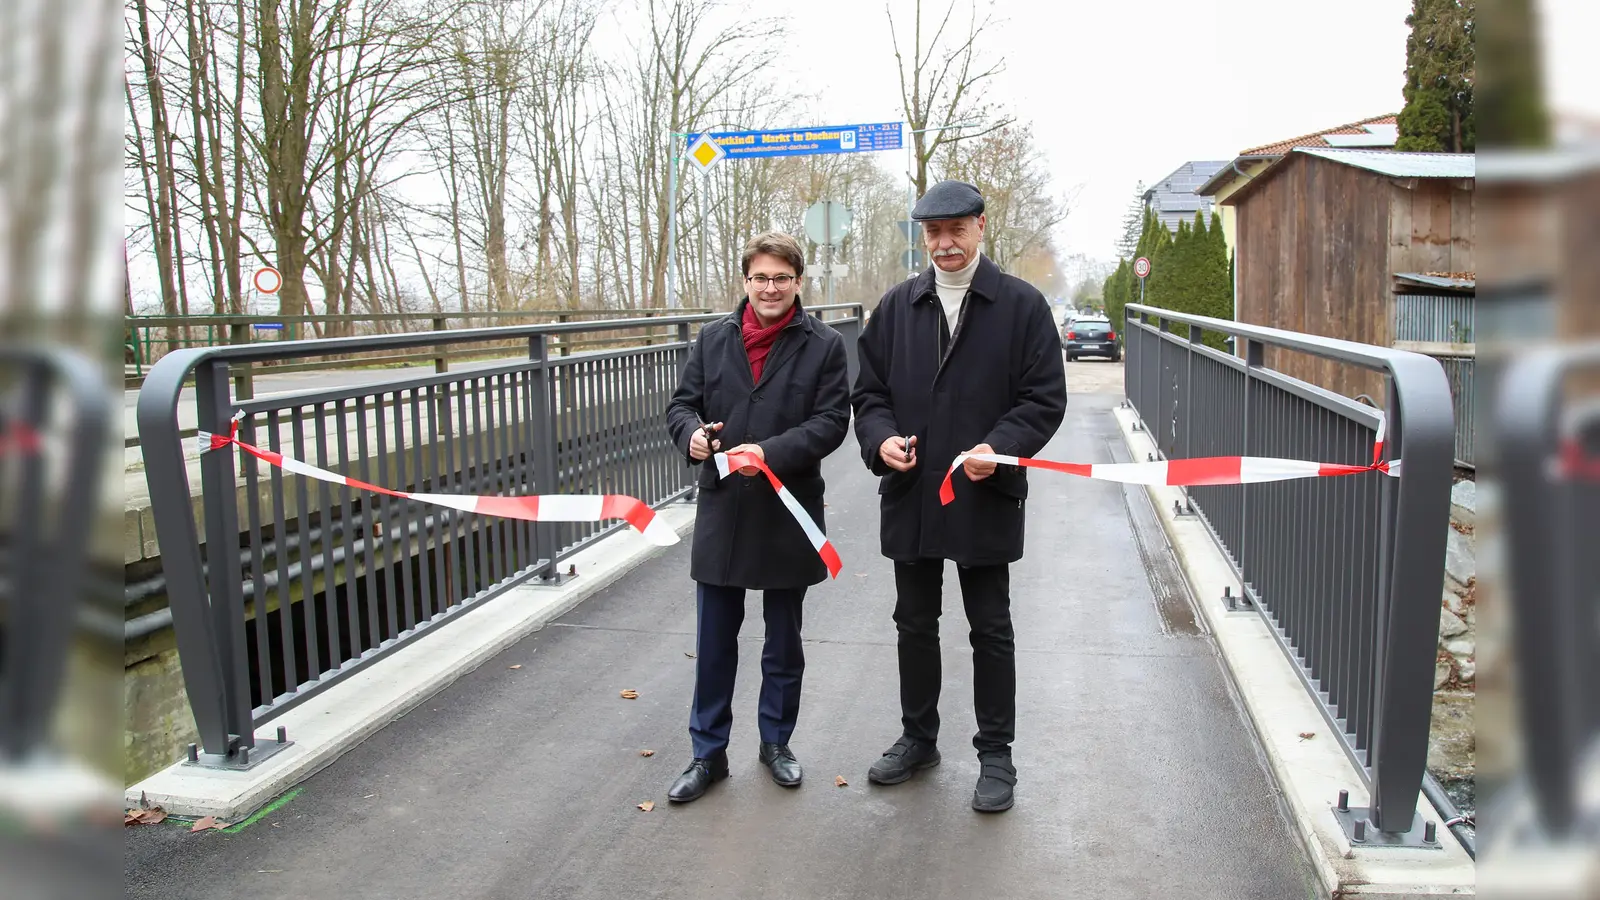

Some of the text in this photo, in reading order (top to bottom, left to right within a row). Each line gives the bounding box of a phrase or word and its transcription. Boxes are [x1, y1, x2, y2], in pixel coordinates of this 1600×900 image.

[762, 133, 790, 143] Markt
[793, 132, 803, 141] in
[805, 131, 839, 141] Dachau
[1138, 262, 1147, 272] 30
